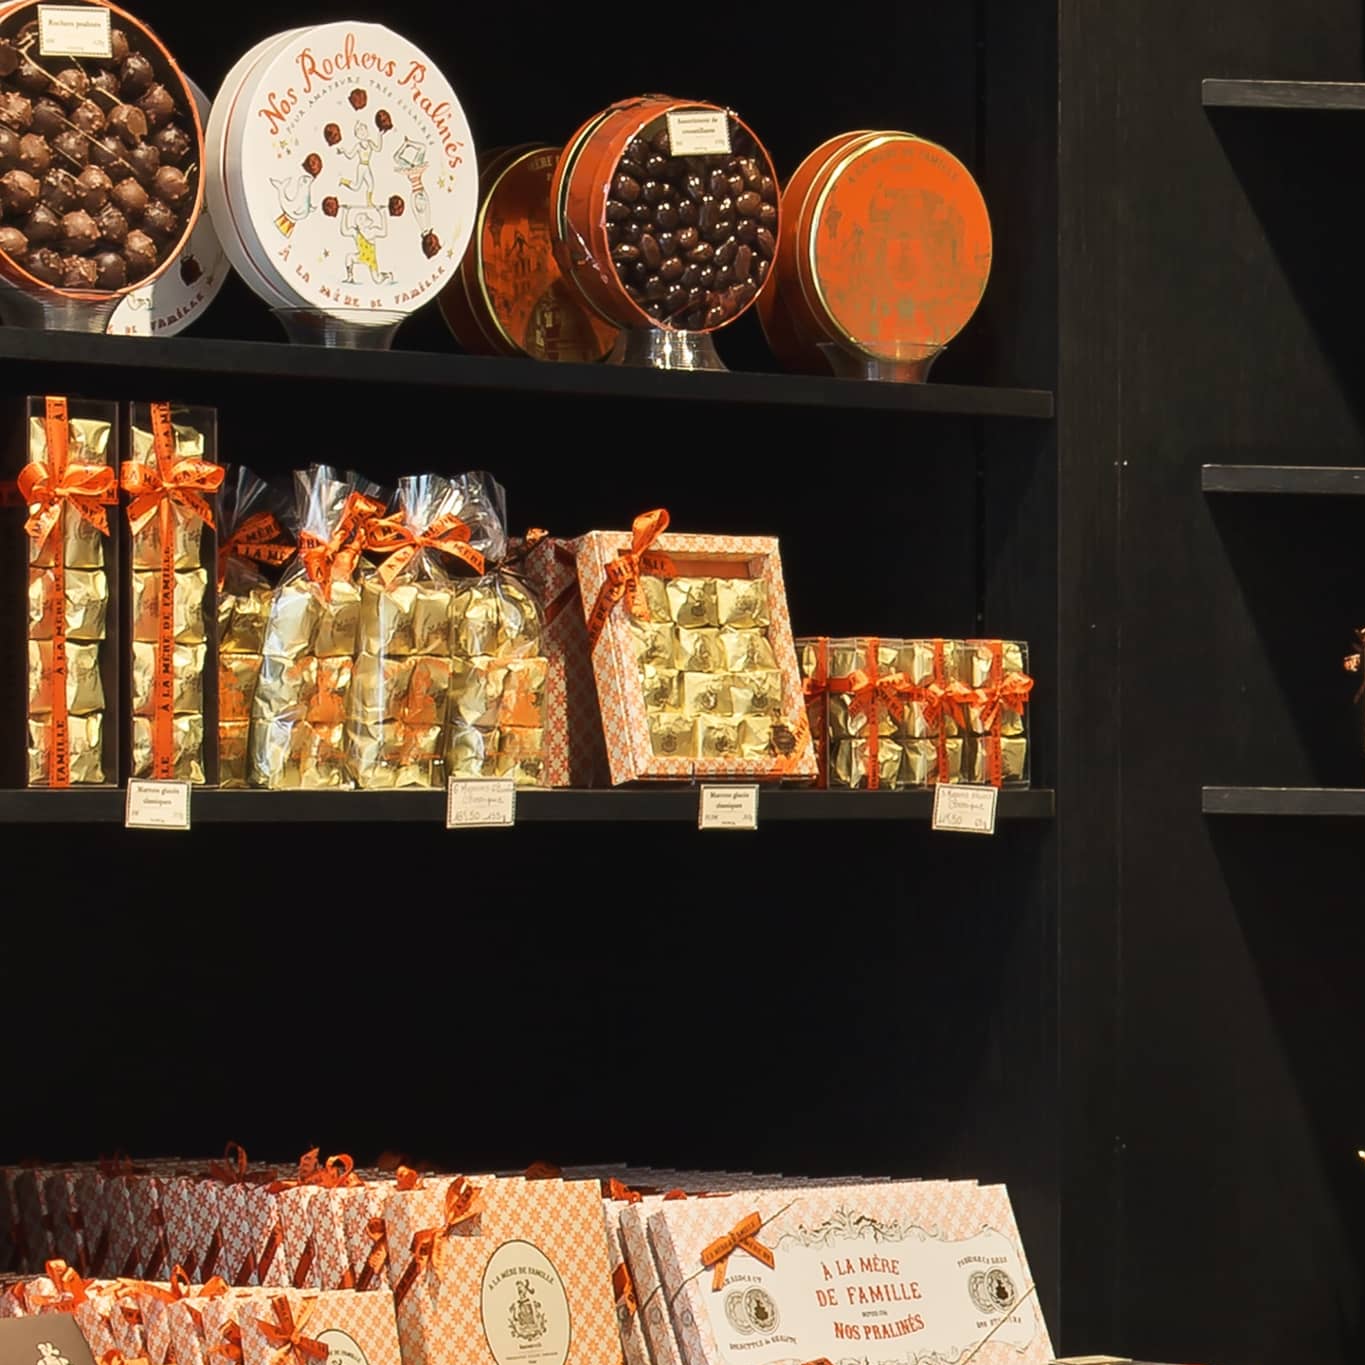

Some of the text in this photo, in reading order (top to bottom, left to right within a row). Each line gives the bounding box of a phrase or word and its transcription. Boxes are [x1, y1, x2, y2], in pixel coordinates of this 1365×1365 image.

[258, 32, 465, 170] Nos Rochers Pralinés
[821, 1255, 900, 1281] À LA MÈRE
[816, 1281, 922, 1308] DE FAMILLE
[833, 1313, 925, 1341] NOS PRALINÉS
